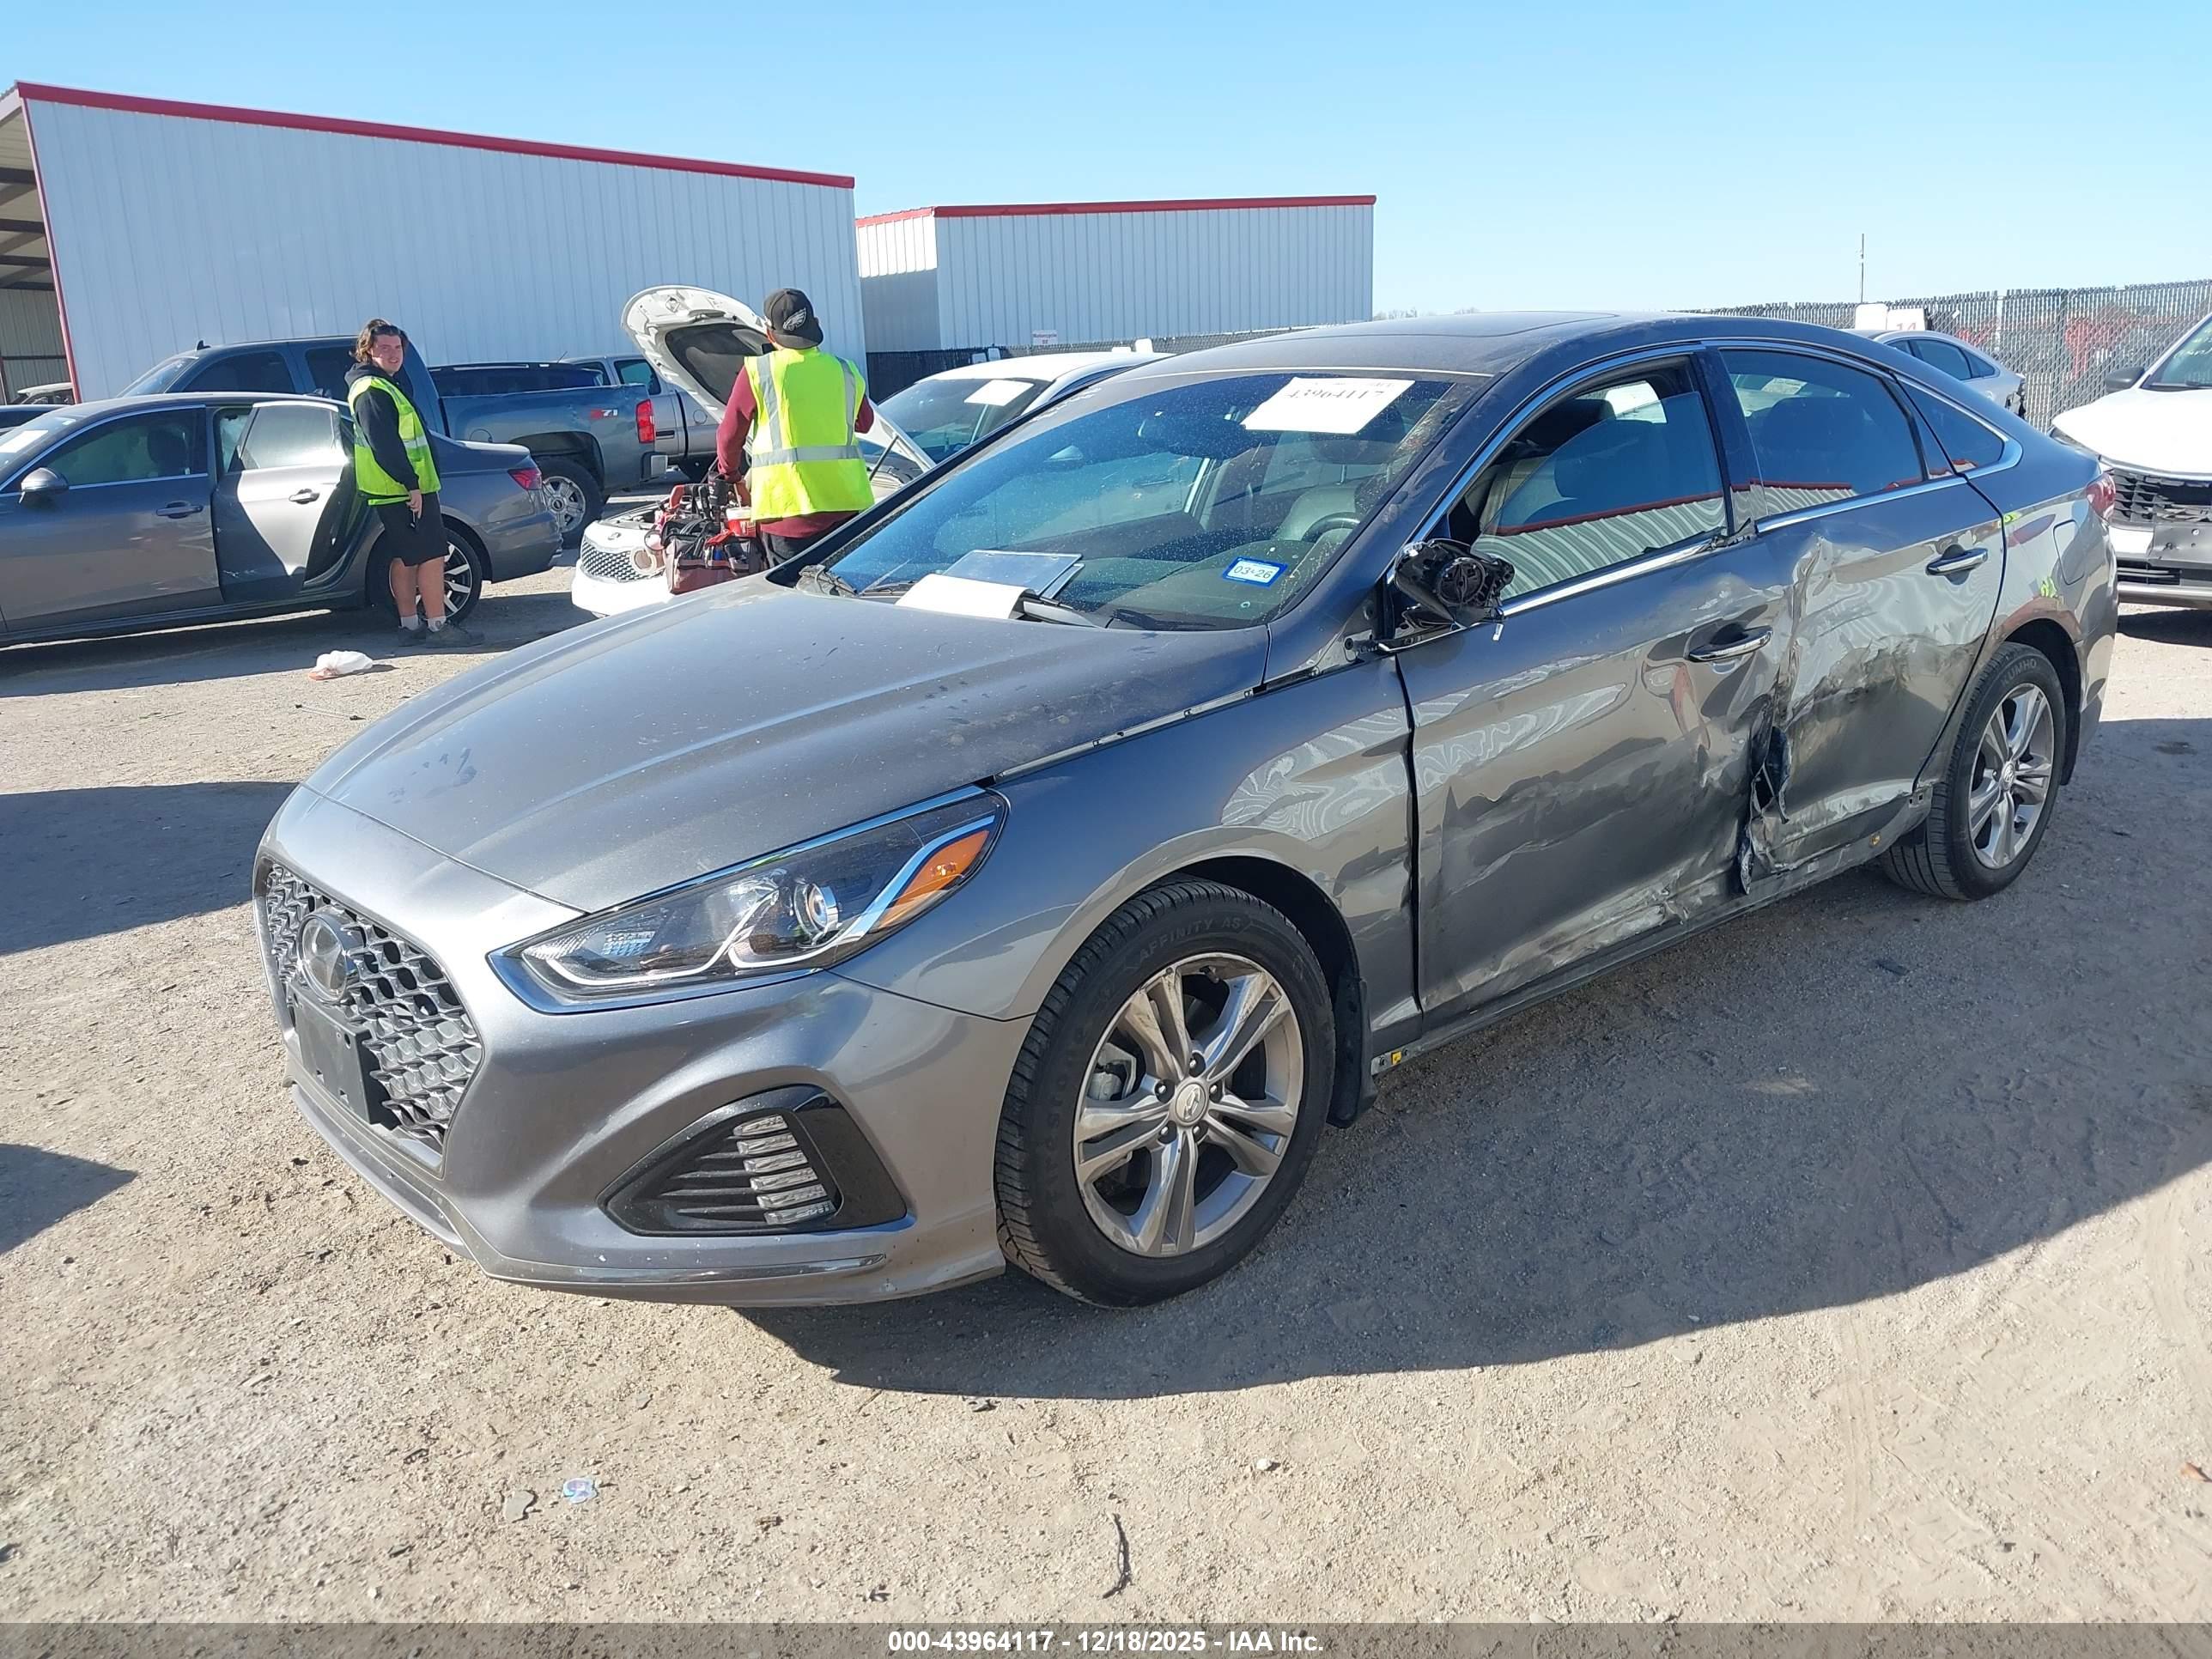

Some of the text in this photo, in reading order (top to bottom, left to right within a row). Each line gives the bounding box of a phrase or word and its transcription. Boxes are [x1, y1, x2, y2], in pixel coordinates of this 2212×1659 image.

[2000, 658, 2037, 686] KUMHO
[1139, 916, 1242, 963] AFFINITY AS
